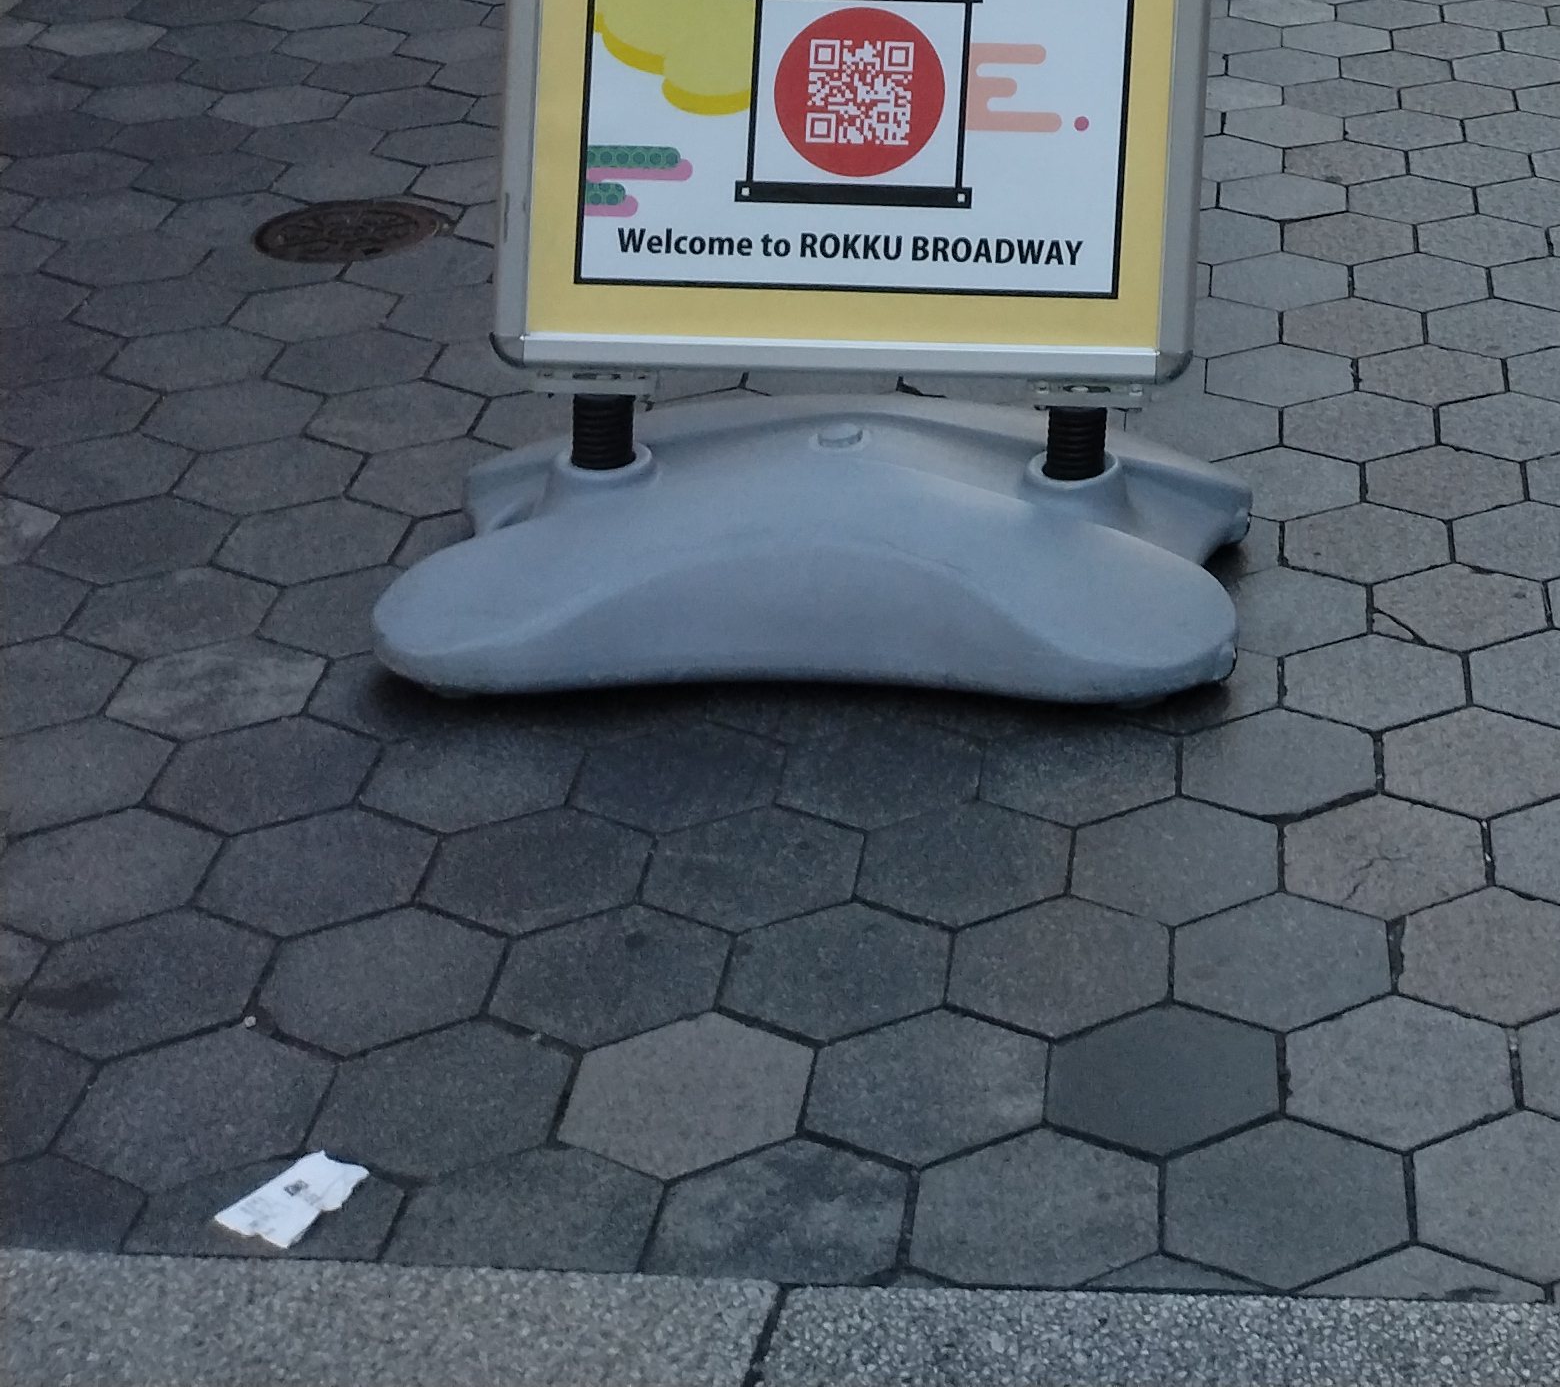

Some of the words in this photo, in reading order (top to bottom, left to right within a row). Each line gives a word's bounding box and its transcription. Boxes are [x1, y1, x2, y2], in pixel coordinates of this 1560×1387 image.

[617, 225, 752, 257] Welcome
[762, 230, 792, 258] to
[800, 231, 903, 261] ROKKU
[911, 234, 1085, 267] BROADWAY
